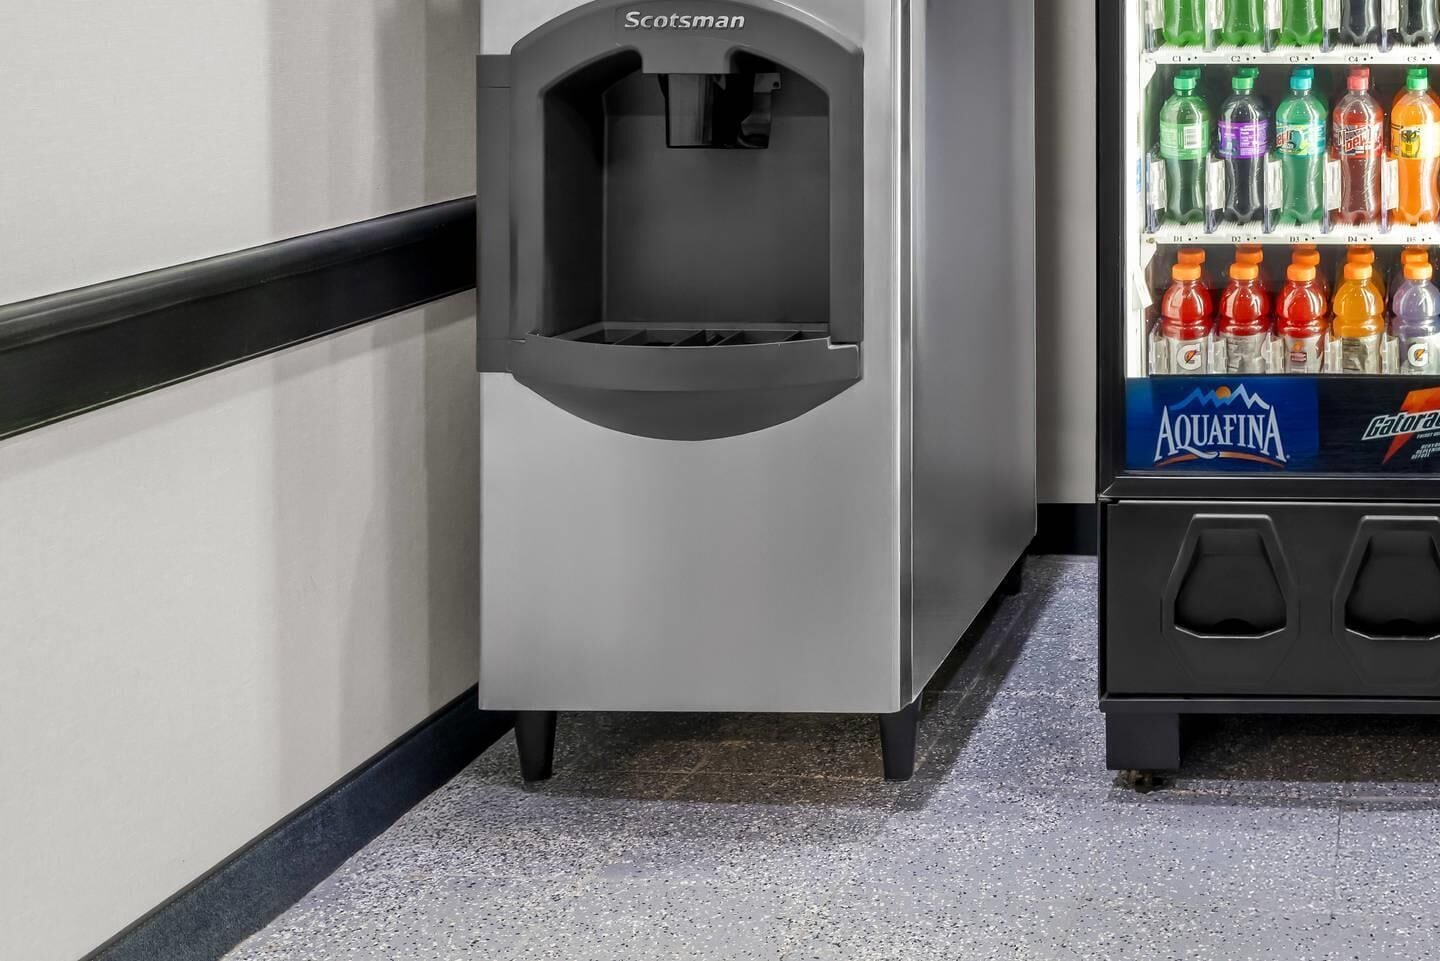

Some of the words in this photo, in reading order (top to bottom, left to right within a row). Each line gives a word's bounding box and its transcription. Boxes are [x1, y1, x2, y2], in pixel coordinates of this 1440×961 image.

[624, 11, 745, 28] Scotsman
[1172, 55, 1182, 63] C1
[1230, 55, 1240, 63] C2
[1289, 55, 1299, 63] C3
[1348, 55, 1358, 63] C4
[1154, 405, 1287, 463] AQUAFINA
